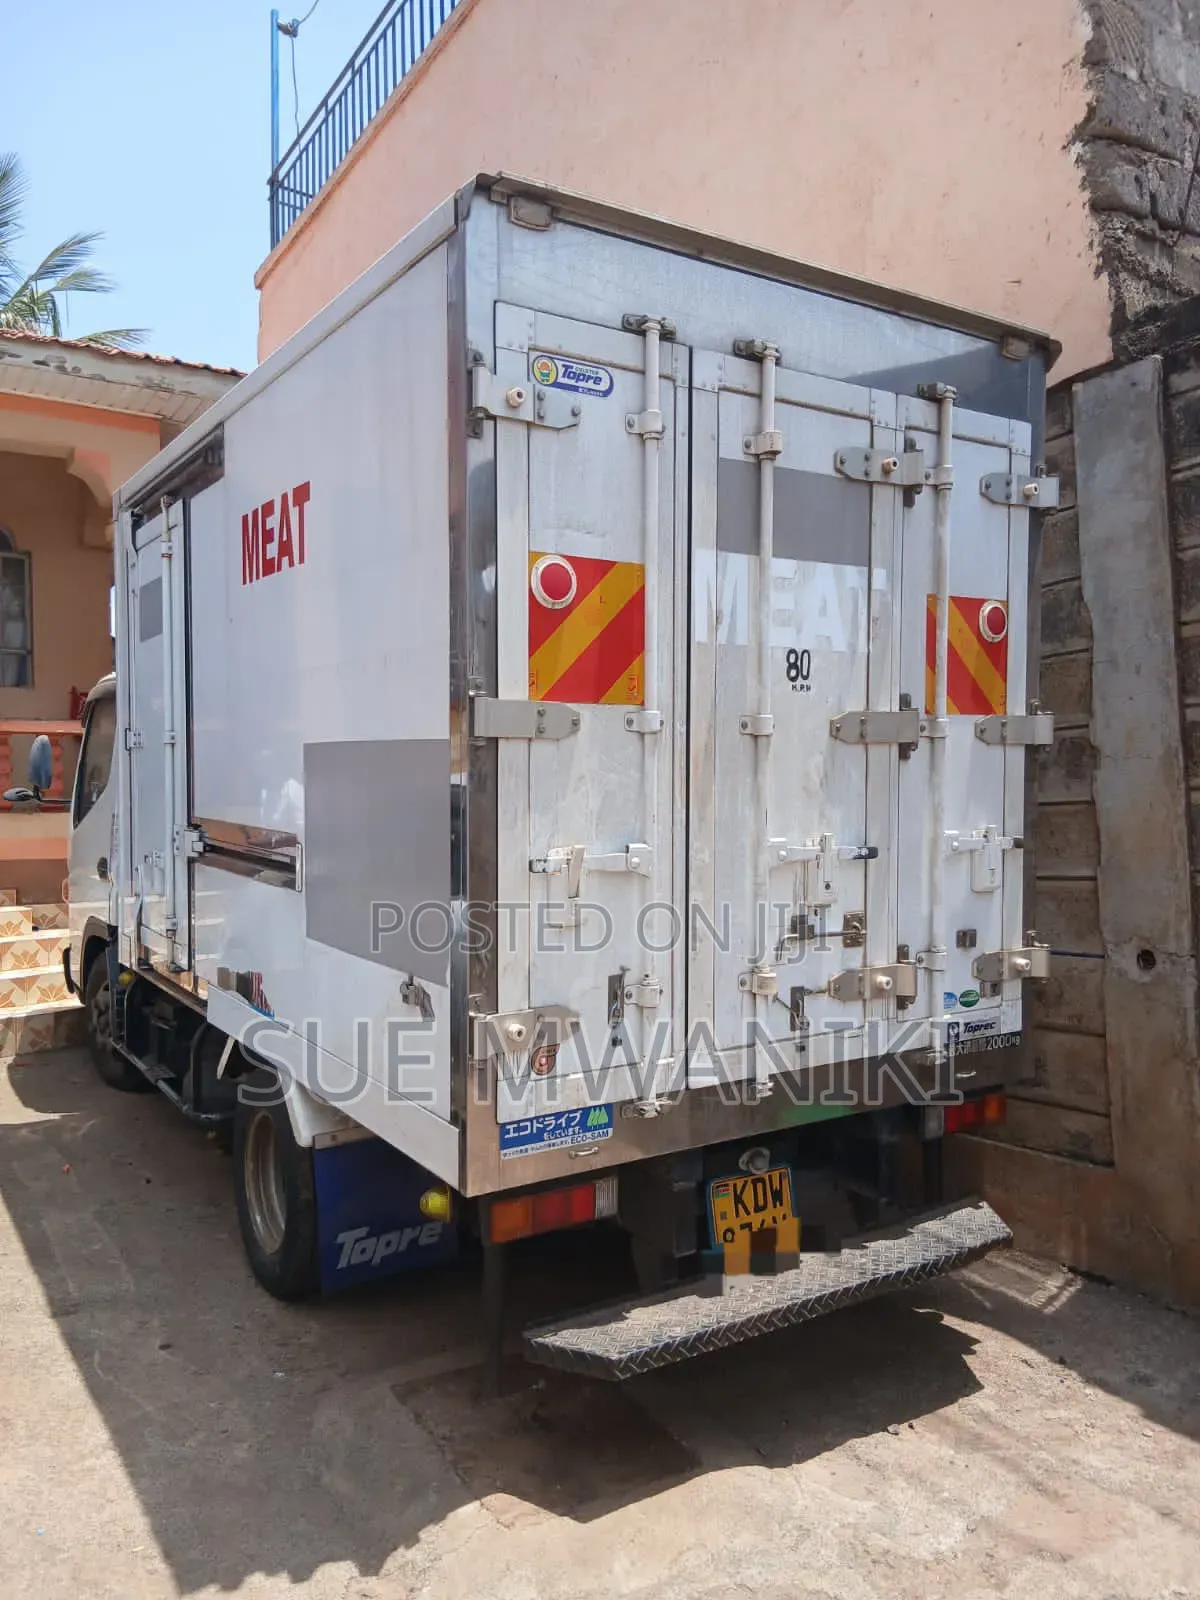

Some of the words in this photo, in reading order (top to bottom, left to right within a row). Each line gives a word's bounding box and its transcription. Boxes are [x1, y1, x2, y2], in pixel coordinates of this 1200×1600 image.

[561, 363, 603, 386] Topre
[241, 480, 311, 586] MEAT
[694, 549, 887, 654] MEAT
[786, 648, 811, 682] 80
[504, 1110, 583, 1138] エコドライブ
[570, 1129, 609, 1145] ECO-SAM
[732, 1172, 784, 1219] KDW
[335, 1220, 443, 1270] Topre
